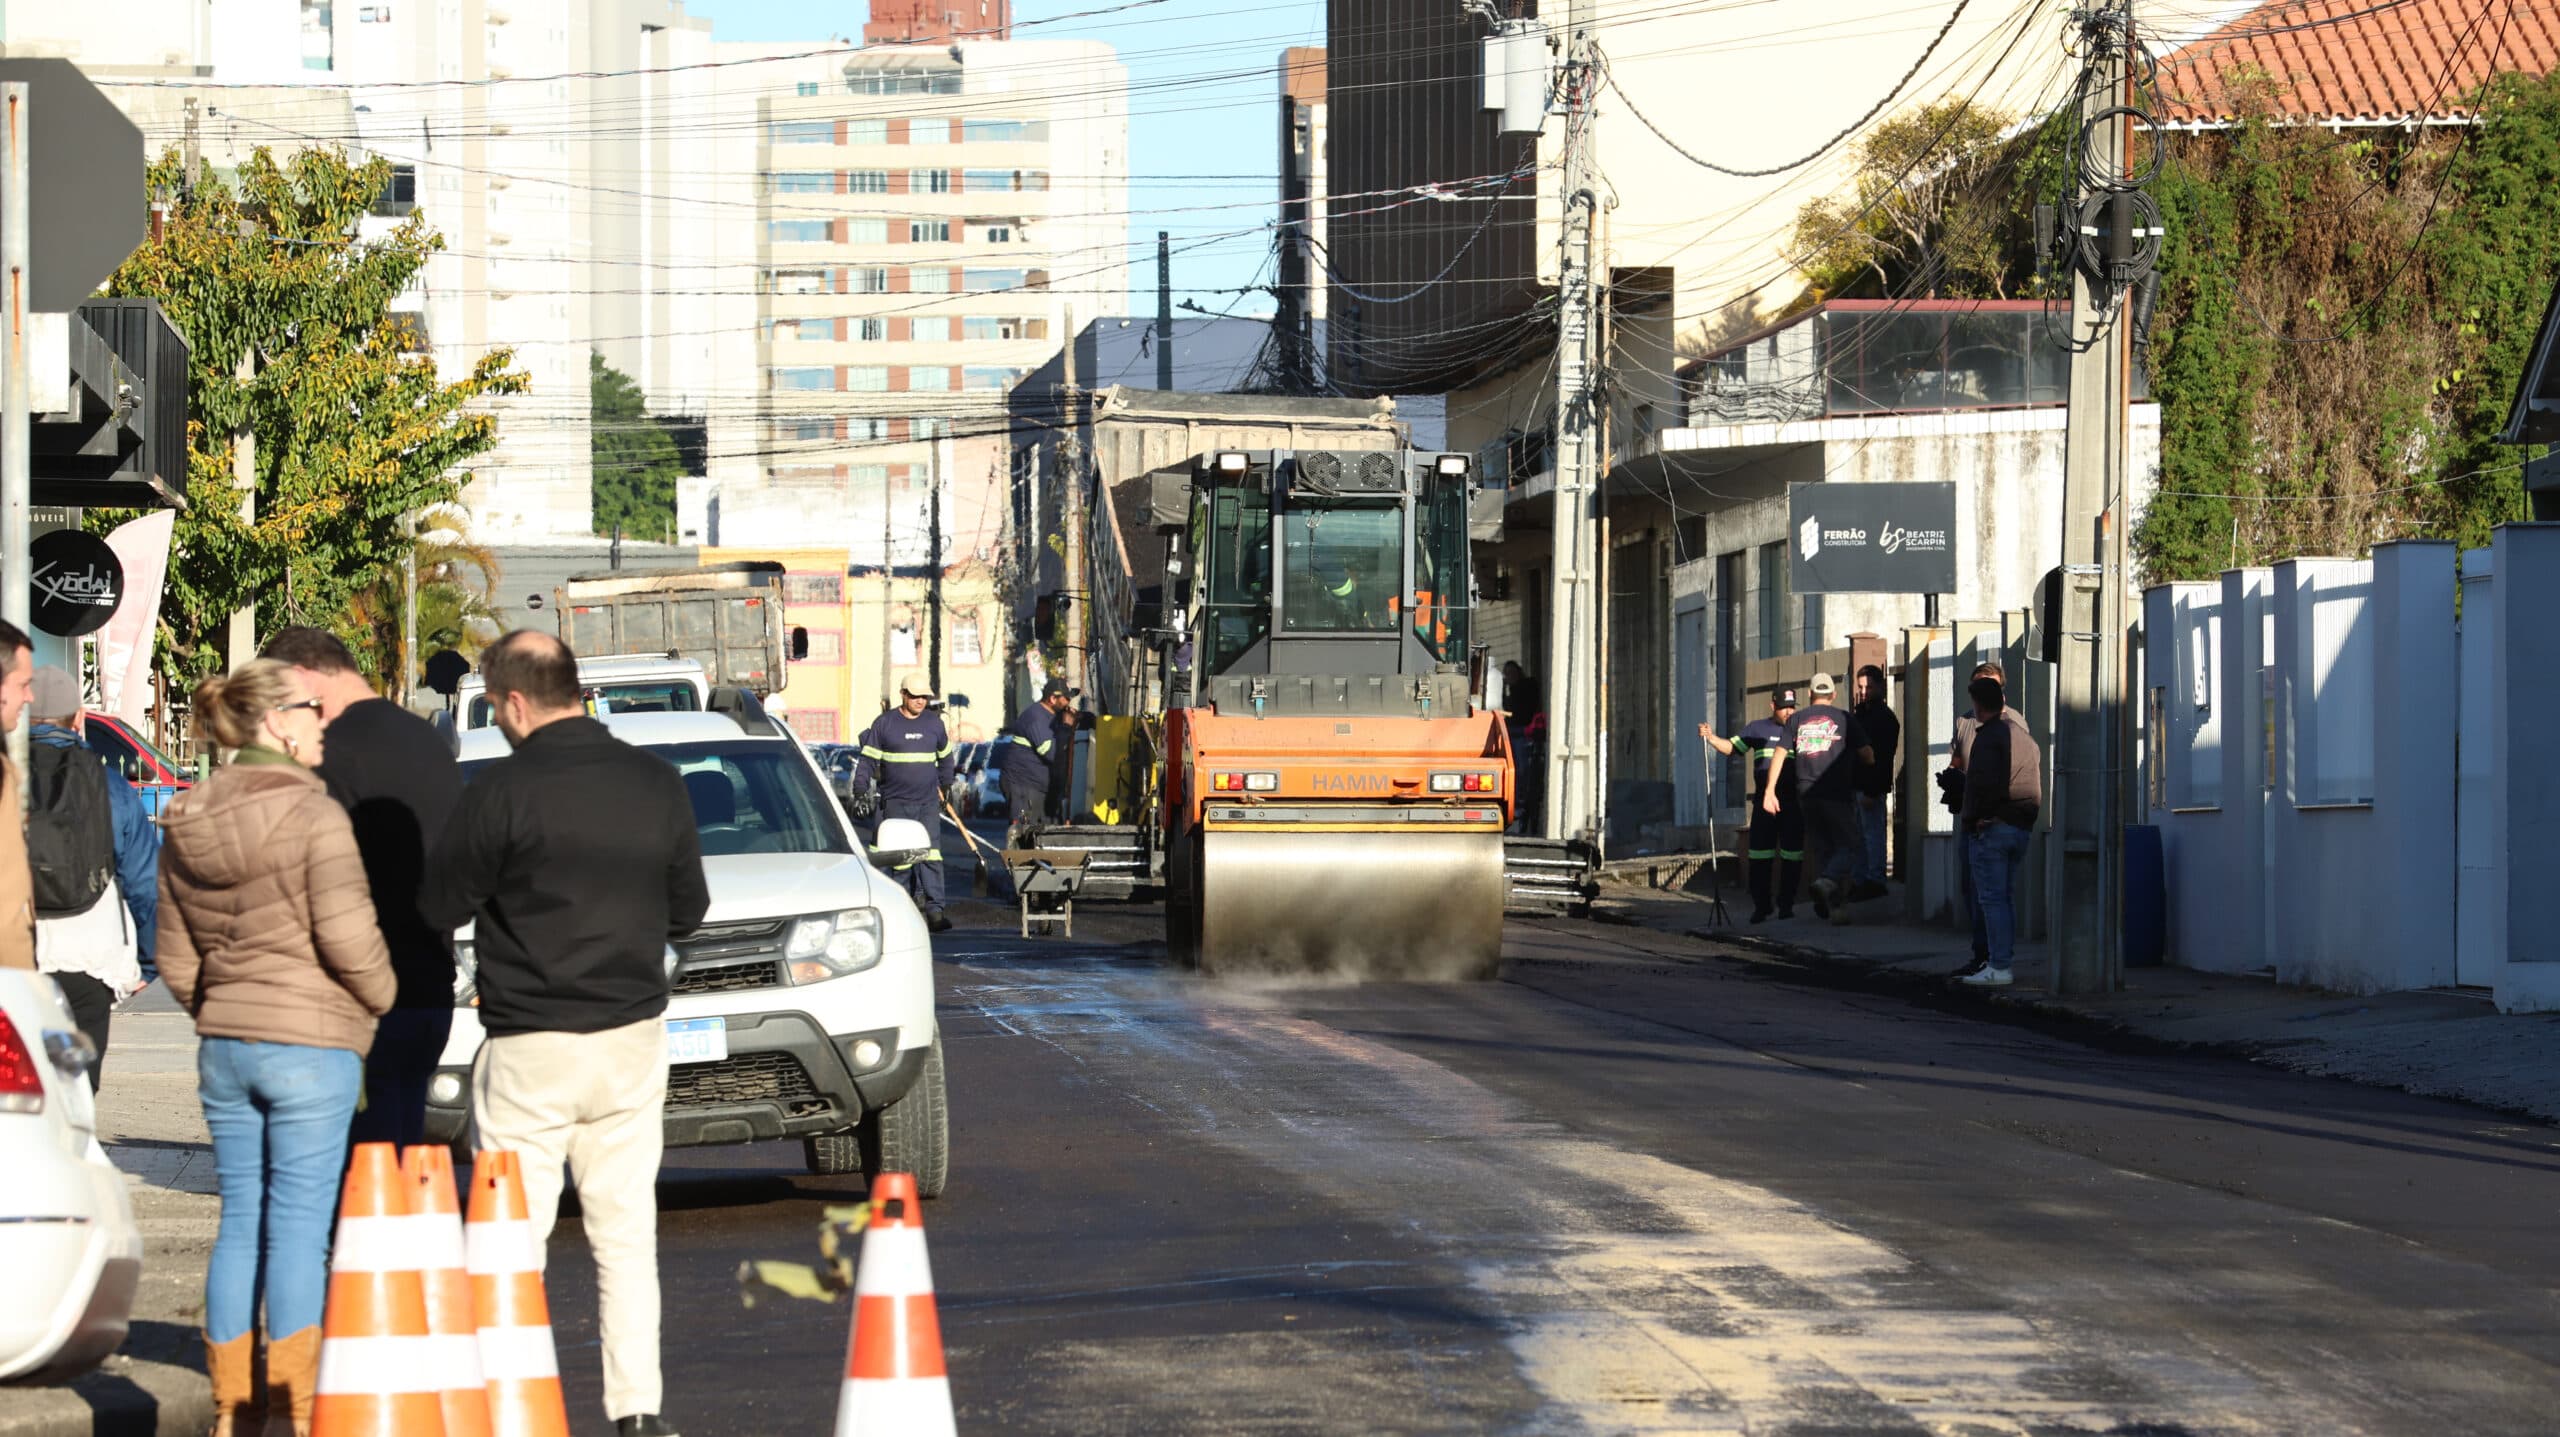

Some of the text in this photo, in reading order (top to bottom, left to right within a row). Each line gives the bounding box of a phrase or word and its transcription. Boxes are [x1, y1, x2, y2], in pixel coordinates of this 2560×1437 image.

[1823, 527, 1867, 540] FERRÃO
[1906, 530, 1945, 538] BEATRIZ
[1905, 538, 1946, 546] SCARPIN
[1312, 774, 1389, 792] HAMM
